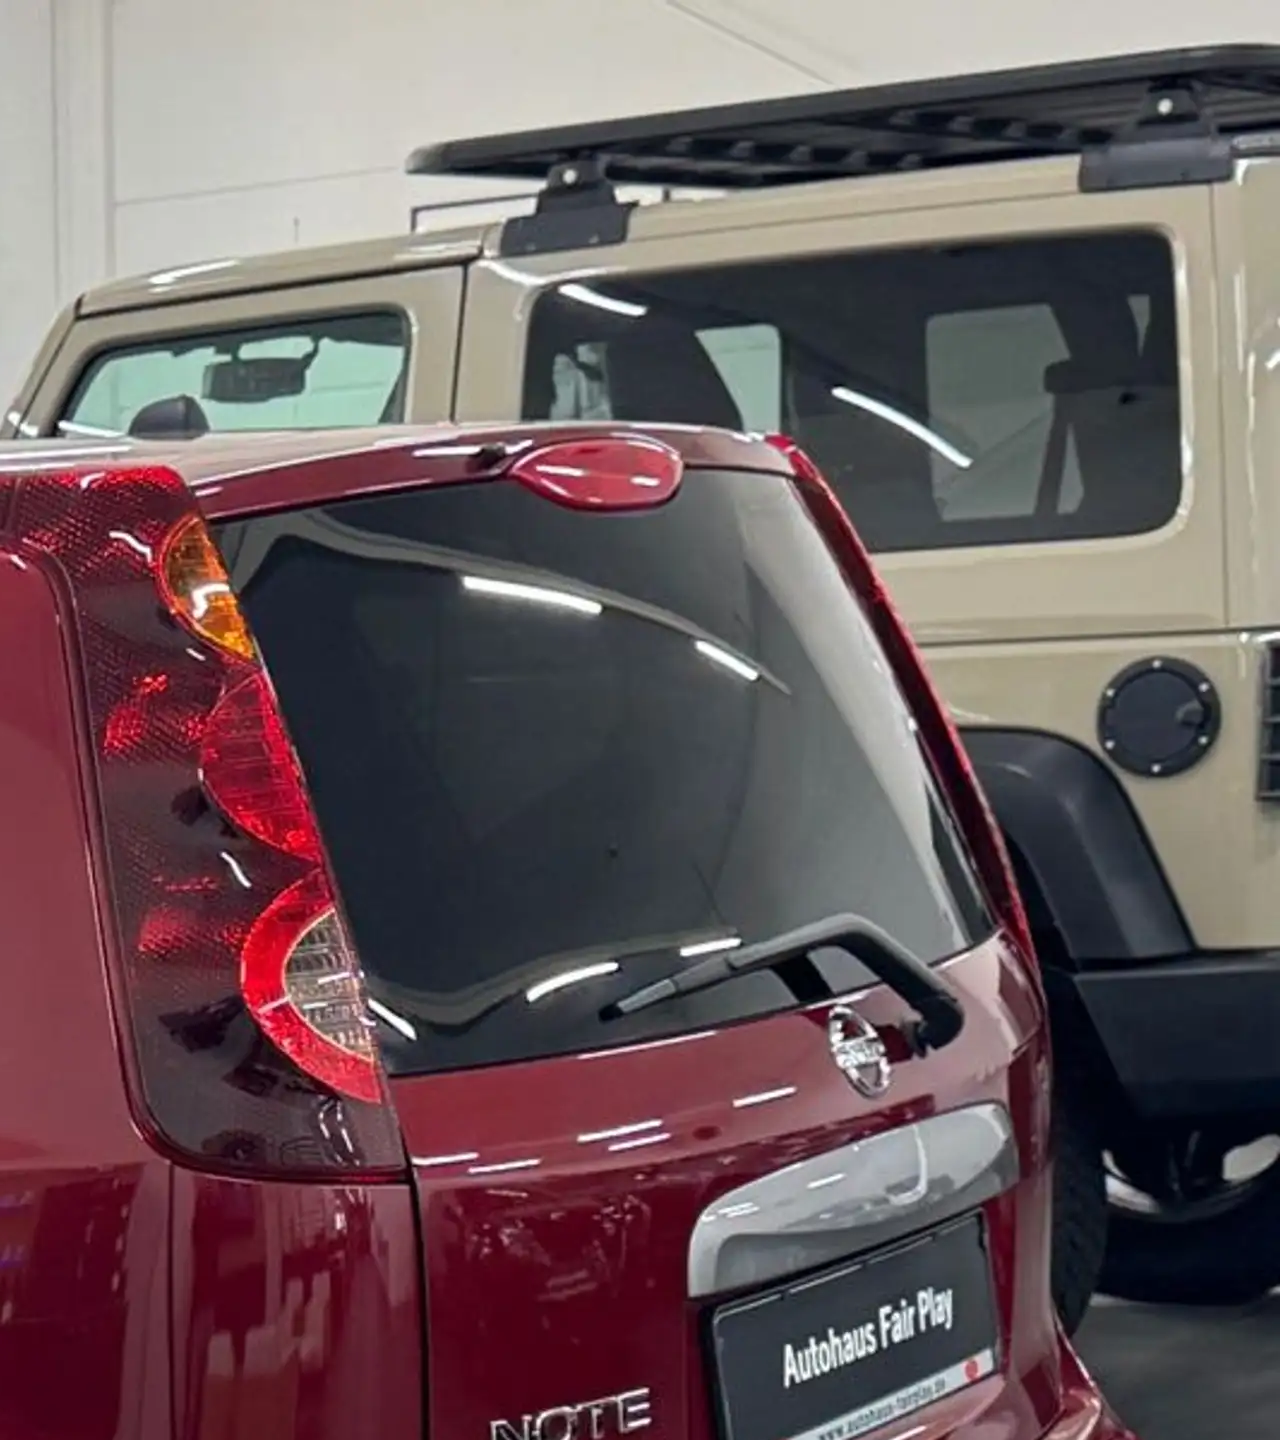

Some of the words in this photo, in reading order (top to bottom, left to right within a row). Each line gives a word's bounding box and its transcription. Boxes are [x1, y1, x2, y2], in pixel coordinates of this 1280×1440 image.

[783, 1321, 878, 1389] Autohaus
[878, 1298, 916, 1349] Fair
[916, 1285, 953, 1332] Play
